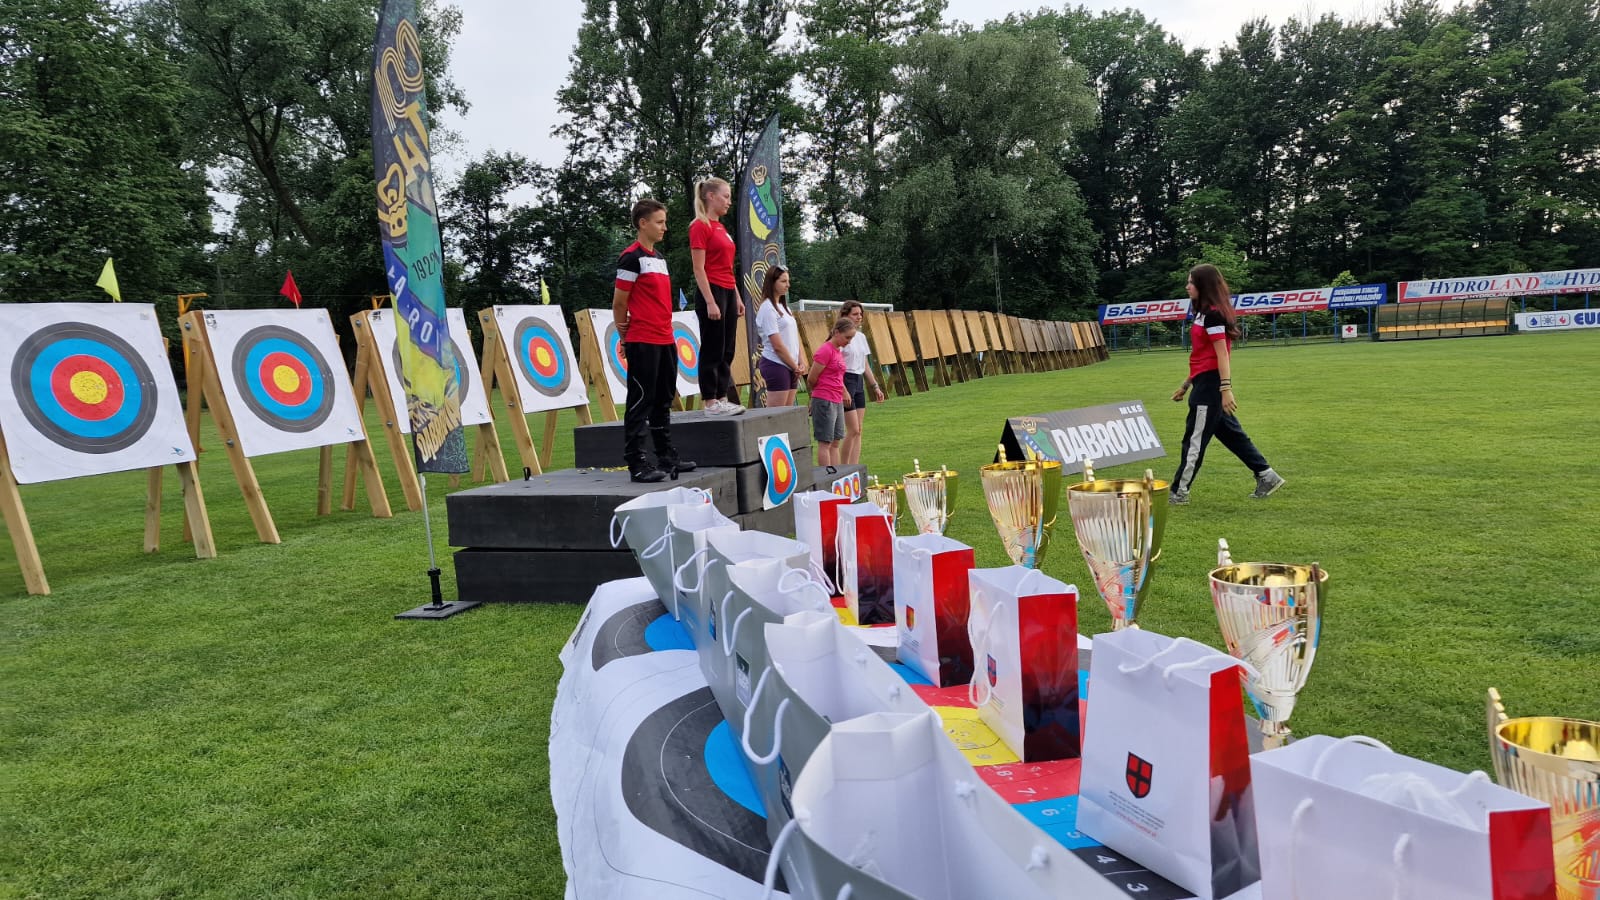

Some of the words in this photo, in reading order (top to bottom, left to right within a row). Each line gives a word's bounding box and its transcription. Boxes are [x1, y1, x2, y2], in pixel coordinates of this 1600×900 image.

[374, 18, 424, 133] 100
[1428, 276, 1540, 294] HYDROLAND
[1573, 311, 1600, 325] EU
[1096, 854, 1118, 864] 4
[1126, 882, 1150, 893] 3
